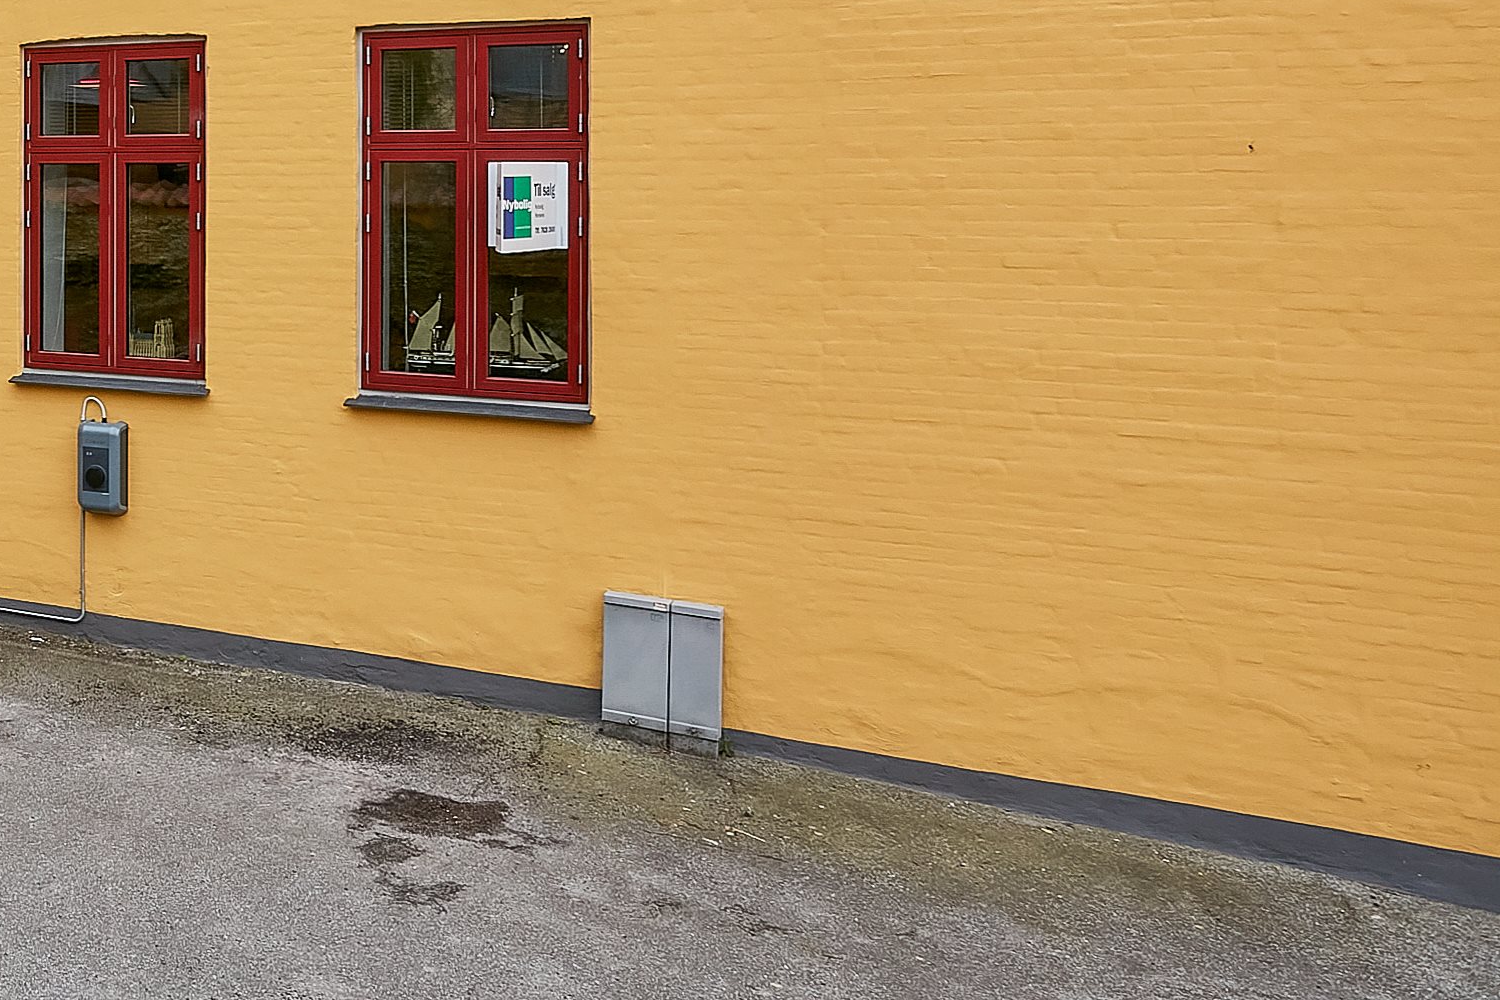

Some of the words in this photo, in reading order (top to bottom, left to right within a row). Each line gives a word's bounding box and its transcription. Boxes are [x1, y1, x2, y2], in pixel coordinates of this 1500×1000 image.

[534, 183, 542, 197] Til
[543, 183, 556, 199] salg
[502, 199, 532, 213] Nybolig
